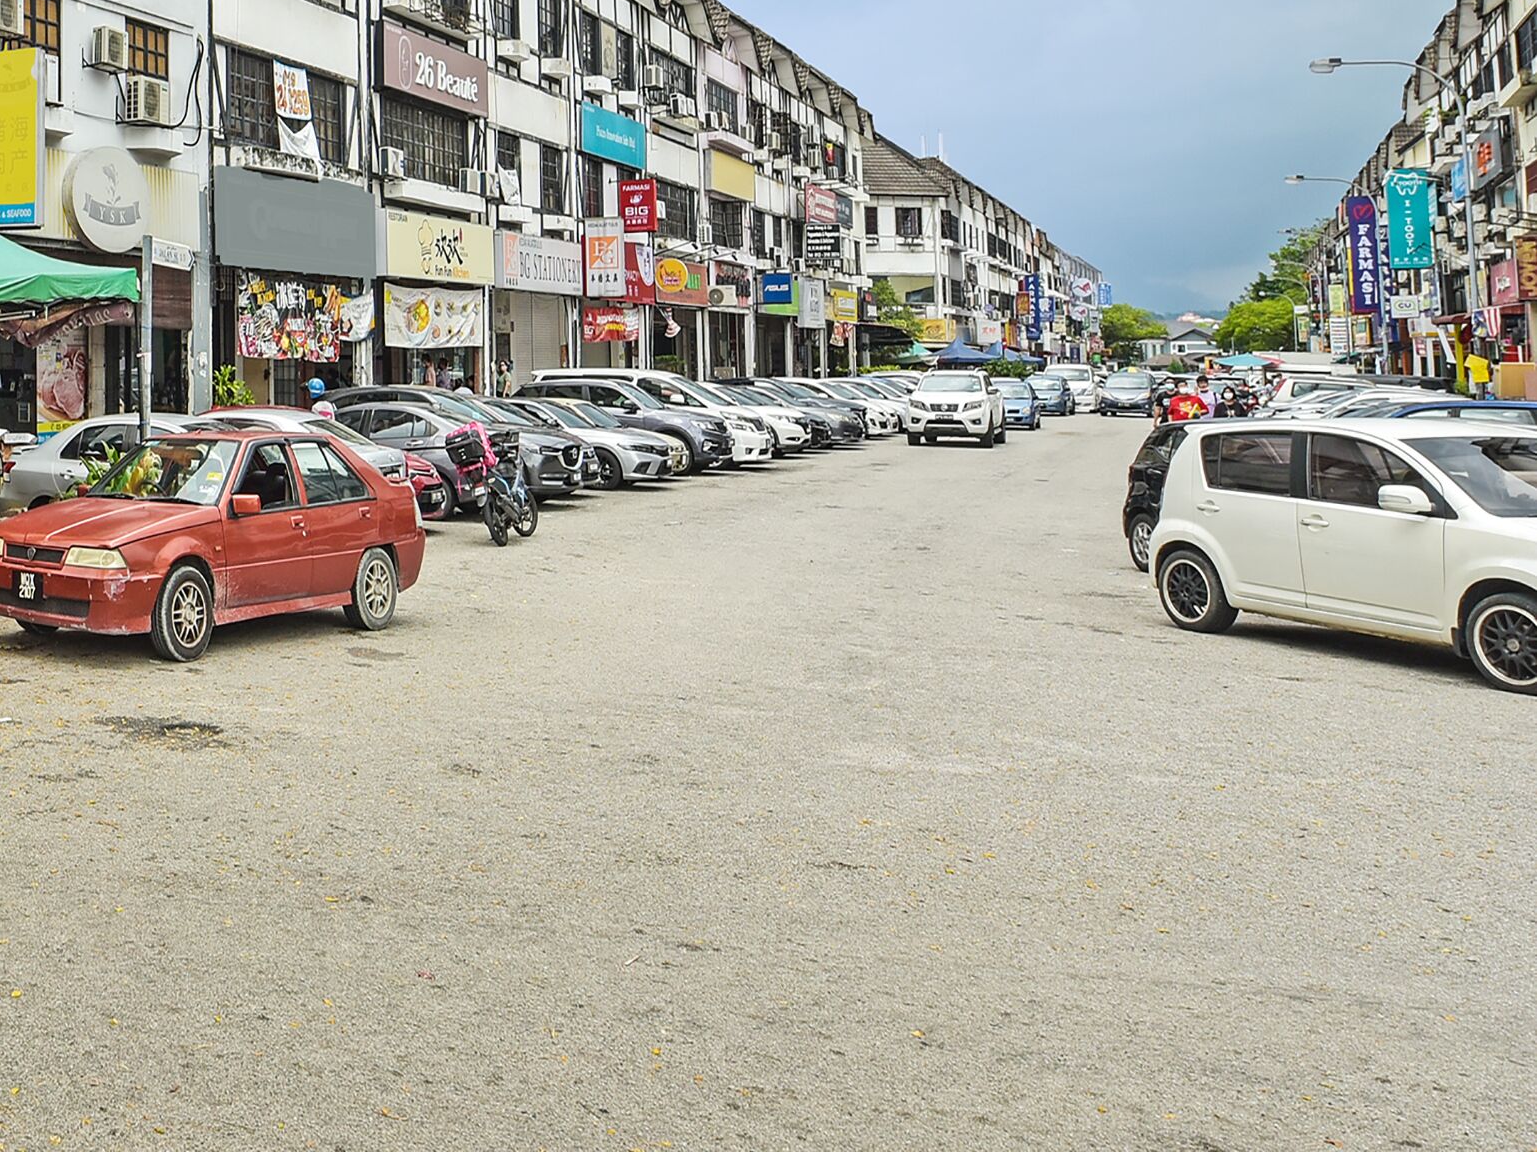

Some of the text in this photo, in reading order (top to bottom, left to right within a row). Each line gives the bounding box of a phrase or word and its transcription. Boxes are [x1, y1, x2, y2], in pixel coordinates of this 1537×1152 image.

[414, 51, 479, 102] 26 Beauté
[623, 183, 651, 192] FARMASI
[6, 207, 32, 218] SEAFOOD
[624, 206, 649, 217] BIG
[519, 251, 531, 280] BG
[1357, 224, 1375, 305] FARMASI
[19, 584, 36, 600] 2107
